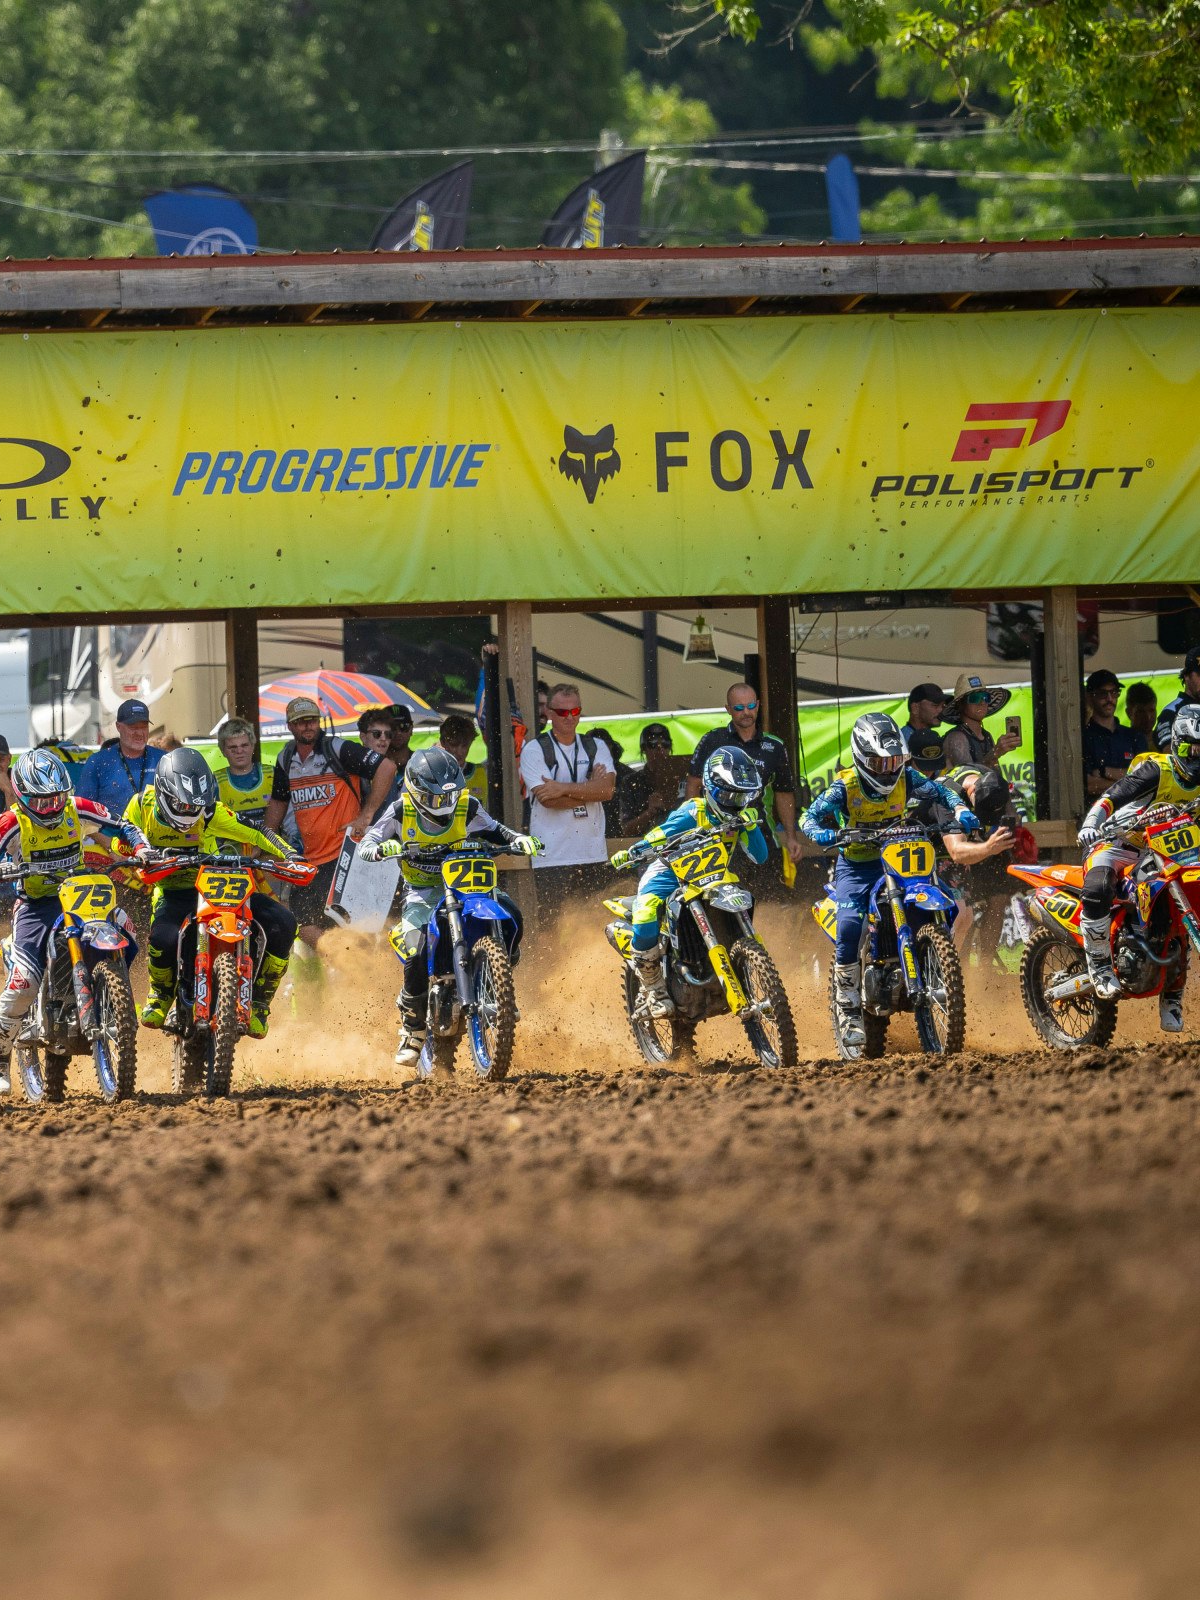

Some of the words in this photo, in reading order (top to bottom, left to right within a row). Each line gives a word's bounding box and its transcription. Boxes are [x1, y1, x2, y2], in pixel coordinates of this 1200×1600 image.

[172, 444, 492, 497] PROGRESSIVE
[654, 429, 815, 493] FOX
[870, 467, 1144, 498] POLISPORT
[899, 496, 1026, 509] PERFORMANCE
[1036, 493, 1092, 504] PARTS
[1162, 829, 1195, 854] 50
[680, 846, 725, 882] 22
[896, 846, 926, 874] 11
[449, 860, 495, 888] 25
[698, 873, 720, 886] GETZ
[70, 884, 114, 911] 75
[203, 876, 250, 901] 33
[1046, 892, 1079, 919] 50
